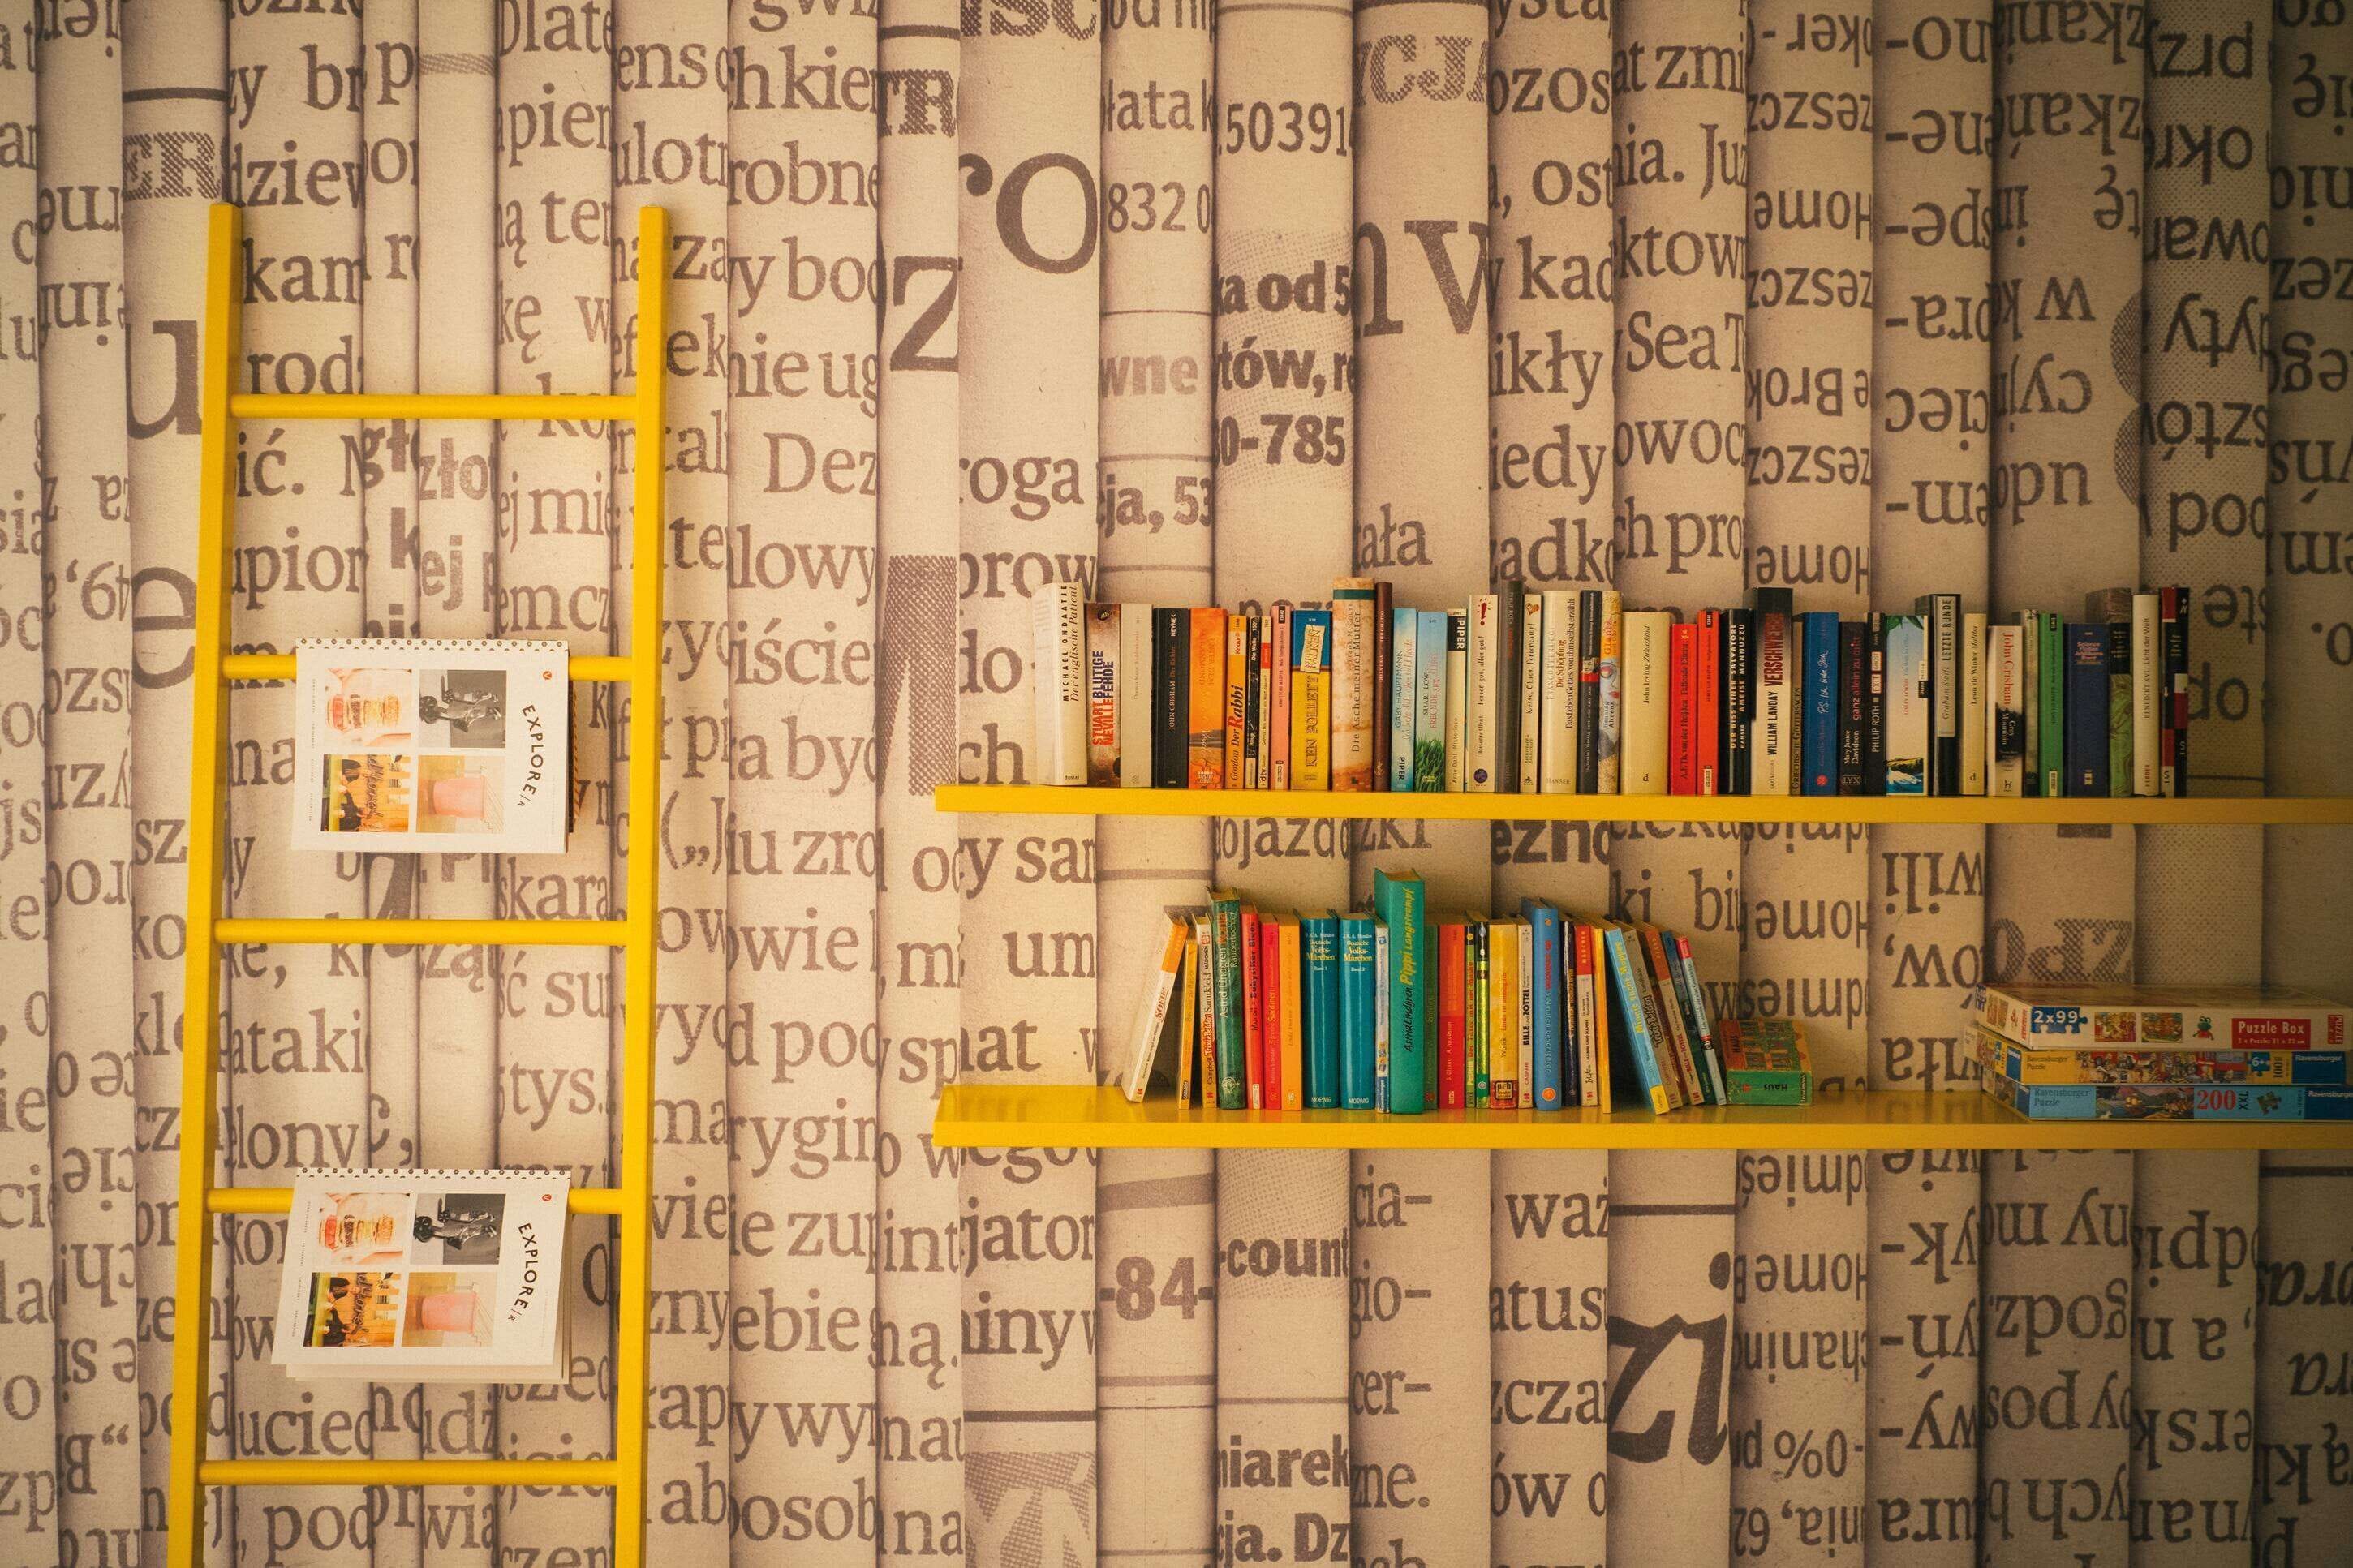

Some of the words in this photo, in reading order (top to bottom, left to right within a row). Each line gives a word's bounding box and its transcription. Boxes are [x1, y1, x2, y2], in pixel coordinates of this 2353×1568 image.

[1068, 586, 1078, 628] Patient
[1942, 599, 1951, 628] RUNDE
[1456, 620, 1465, 649] PIPER
[1942, 631, 1951, 661] LETZTE
[2003, 632, 2014, 657] John
[1069, 629, 1081, 679] englische
[1556, 639, 1567, 677] Schöpfung
[1853, 658, 1860, 669] zu
[1092, 651, 1103, 699] BLUTIGE
[1103, 661, 1114, 698] FEHDE
[1556, 677, 1564, 688] Die
[1851, 671, 1860, 696] allein
[2002, 659, 2014, 705] Grisham
[1070, 681, 1079, 702] Der
[1768, 691, 1778, 720] LANDAY
[1228, 685, 1244, 729] Rabbi
[1352, 695, 1360, 729] Asche
[1395, 706, 1403, 728] GABY
[1852, 698, 1862, 720] ganz
[1872, 705, 1880, 726] ROTH
[1092, 701, 1103, 745] STUART
[1103, 699, 1113, 745] NEVILLE
[1231, 730, 1239, 746] Der
[1305, 738, 1318, 767] KEN
[1352, 734, 1360, 752] Die
[1767, 723, 1779, 755] WILLIAM
[1852, 730, 1860, 764] Davidson
[1872, 728, 1880, 753] PHILIP
[1230, 750, 1239, 780] Gordon
[1259, 768, 1267, 782] dtv
[1402, 887, 1415, 950] Langstrumpf
[1218, 947, 1230, 988] Lindgren
[1343, 954, 1373, 962] Märchen
[1399, 950, 1417, 986] Pippi
[1203, 973, 1212, 1012] Samtkleid
[1219, 990, 1229, 1018] Astrid
[1522, 989, 1530, 1016] ZOTTEL
[2238, 1020, 2277, 1035] Puzzle
[2282, 1021, 2304, 1034] Box
[2196, 1089, 2236, 1110] 200
[2238, 1091, 2249, 1110] XXL
